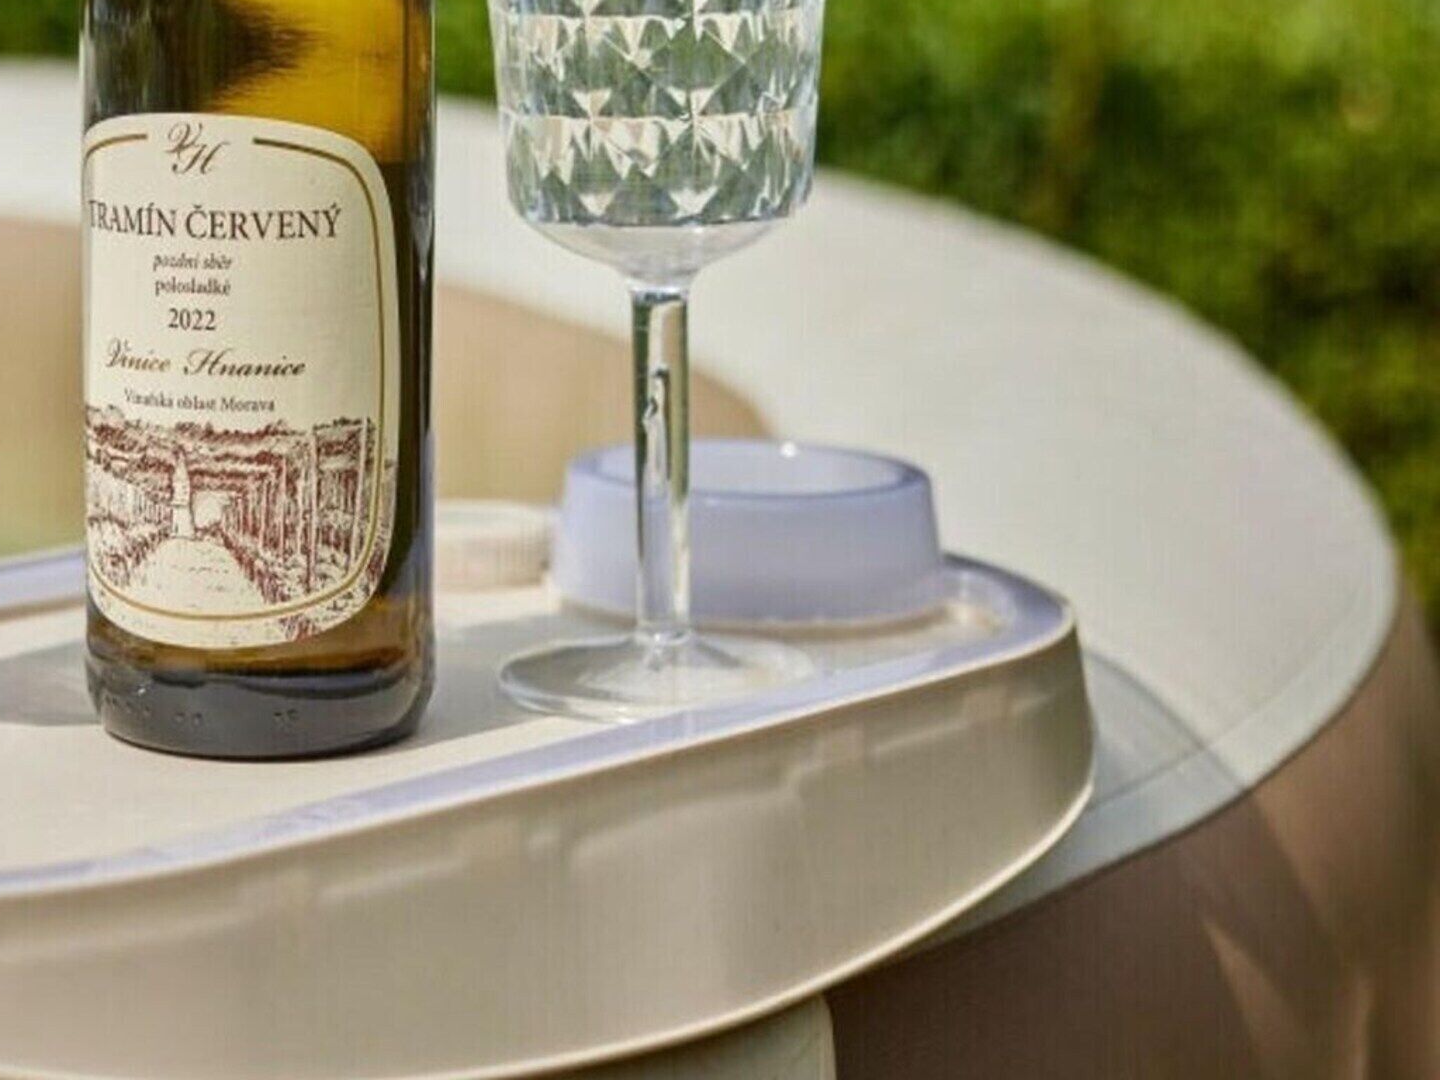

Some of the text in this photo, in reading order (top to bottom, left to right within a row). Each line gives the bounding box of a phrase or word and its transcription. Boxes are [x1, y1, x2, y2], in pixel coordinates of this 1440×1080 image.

[89, 199, 341, 241] TRAMÍN ČERVENÝ
[155, 277, 231, 296] polosladké
[168, 308, 216, 331] 2022
[106, 338, 306, 377] Vinice Hnanice
[177, 394, 215, 411] oblast
[221, 396, 275, 412] Morava
